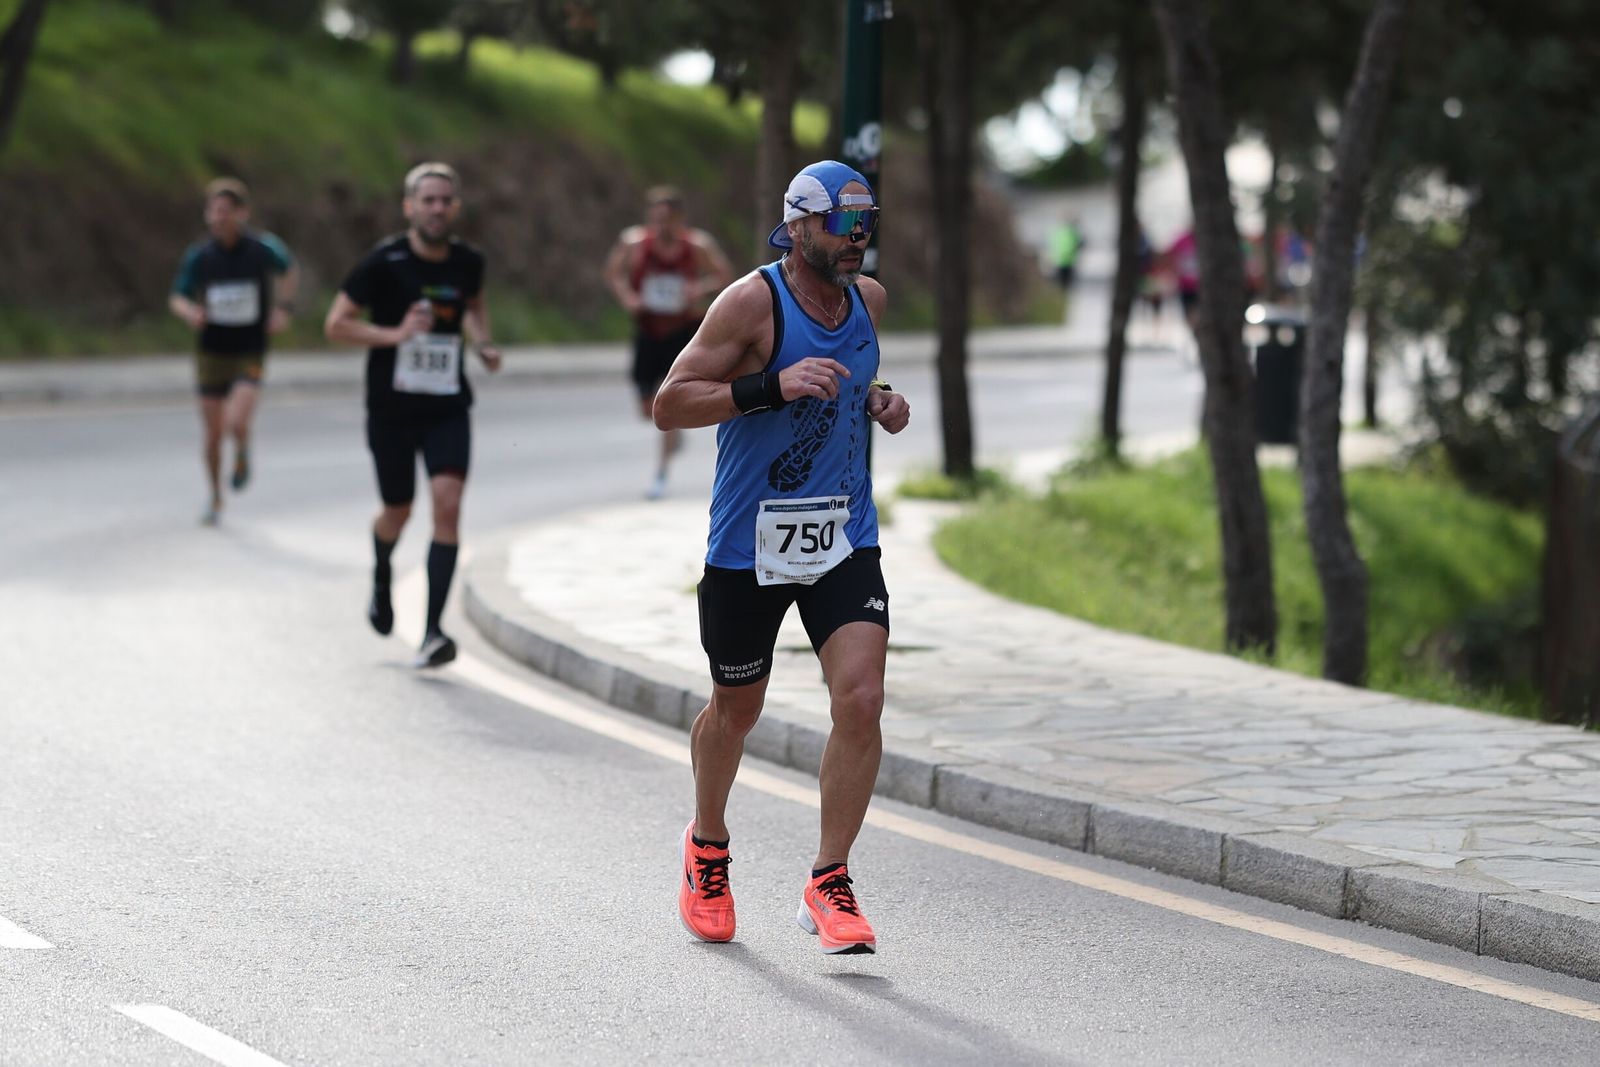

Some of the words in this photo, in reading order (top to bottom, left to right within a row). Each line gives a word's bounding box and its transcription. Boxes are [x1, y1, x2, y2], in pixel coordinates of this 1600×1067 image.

[776, 520, 835, 554] 750
[719, 657, 764, 672] DEPORTES
[724, 667, 761, 679] ESTADIO
